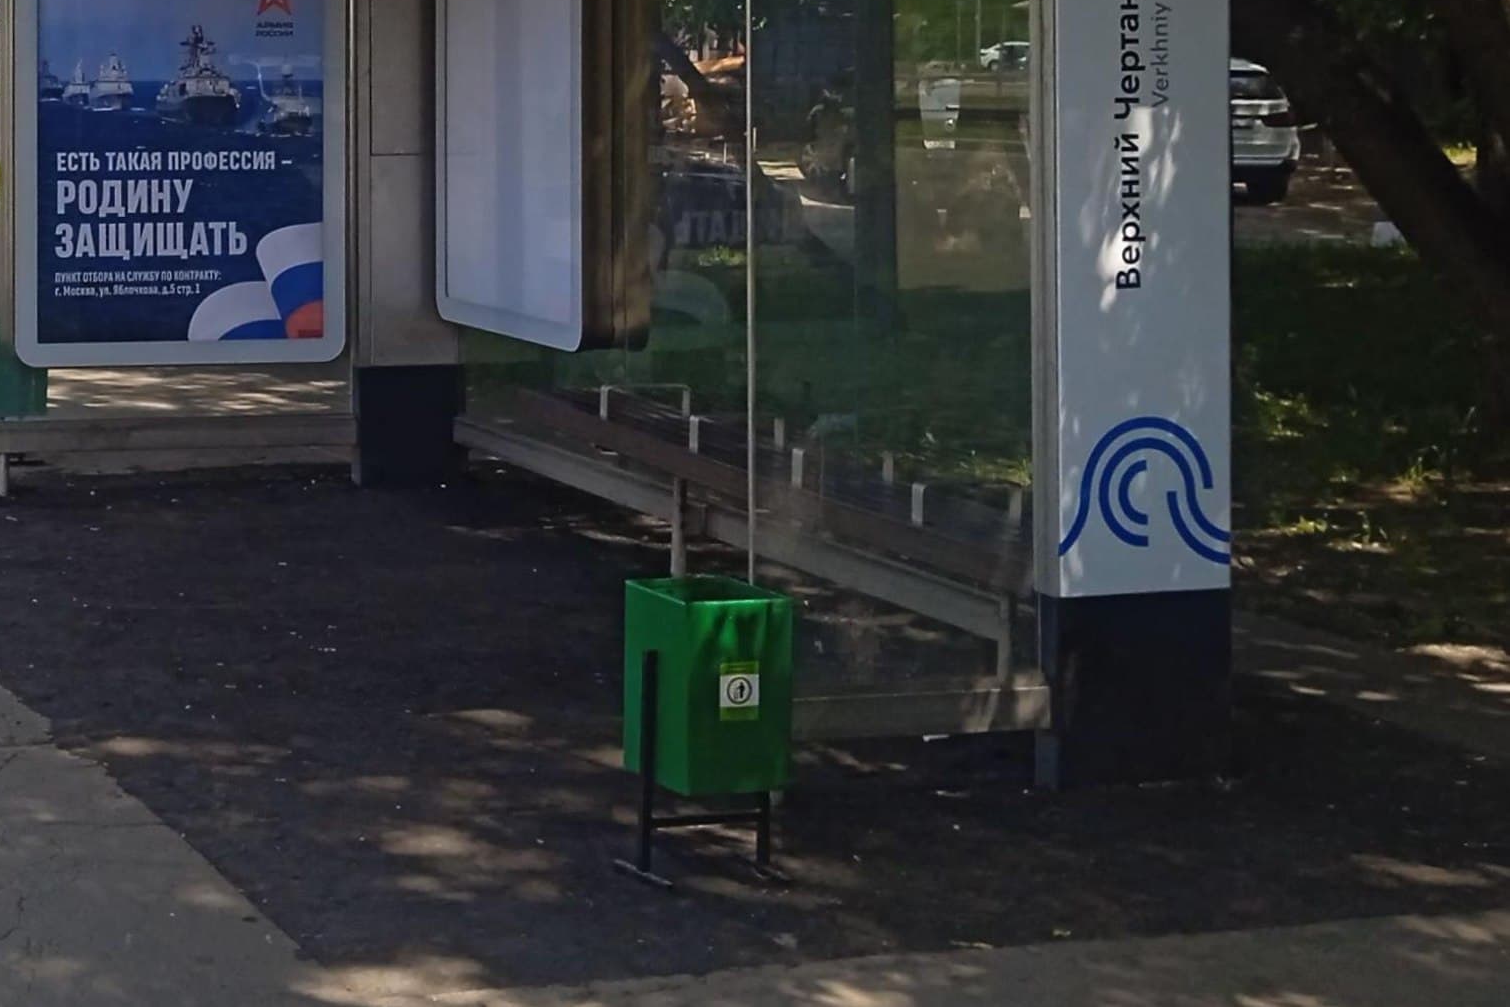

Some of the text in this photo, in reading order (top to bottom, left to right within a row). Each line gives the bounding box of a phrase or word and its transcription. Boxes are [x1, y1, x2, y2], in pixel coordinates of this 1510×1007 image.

[1150, 2, 1172, 108] Verkhniy
[57, 152, 100, 171] ЕСТЬ
[105, 152, 162, 171] ТАКАЯ
[168, 151, 275, 170] ПРОФЕССИЯ
[56, 179, 193, 217] РОДИНУ
[1114, 133, 1146, 290] Верхний
[55, 221, 247, 260] ЗАЩИЩАТЬ
[55, 270, 221, 283] ПУНКТ ОТБОРА НА СЛУЖБУ ПО КОНТРАКТУ:
